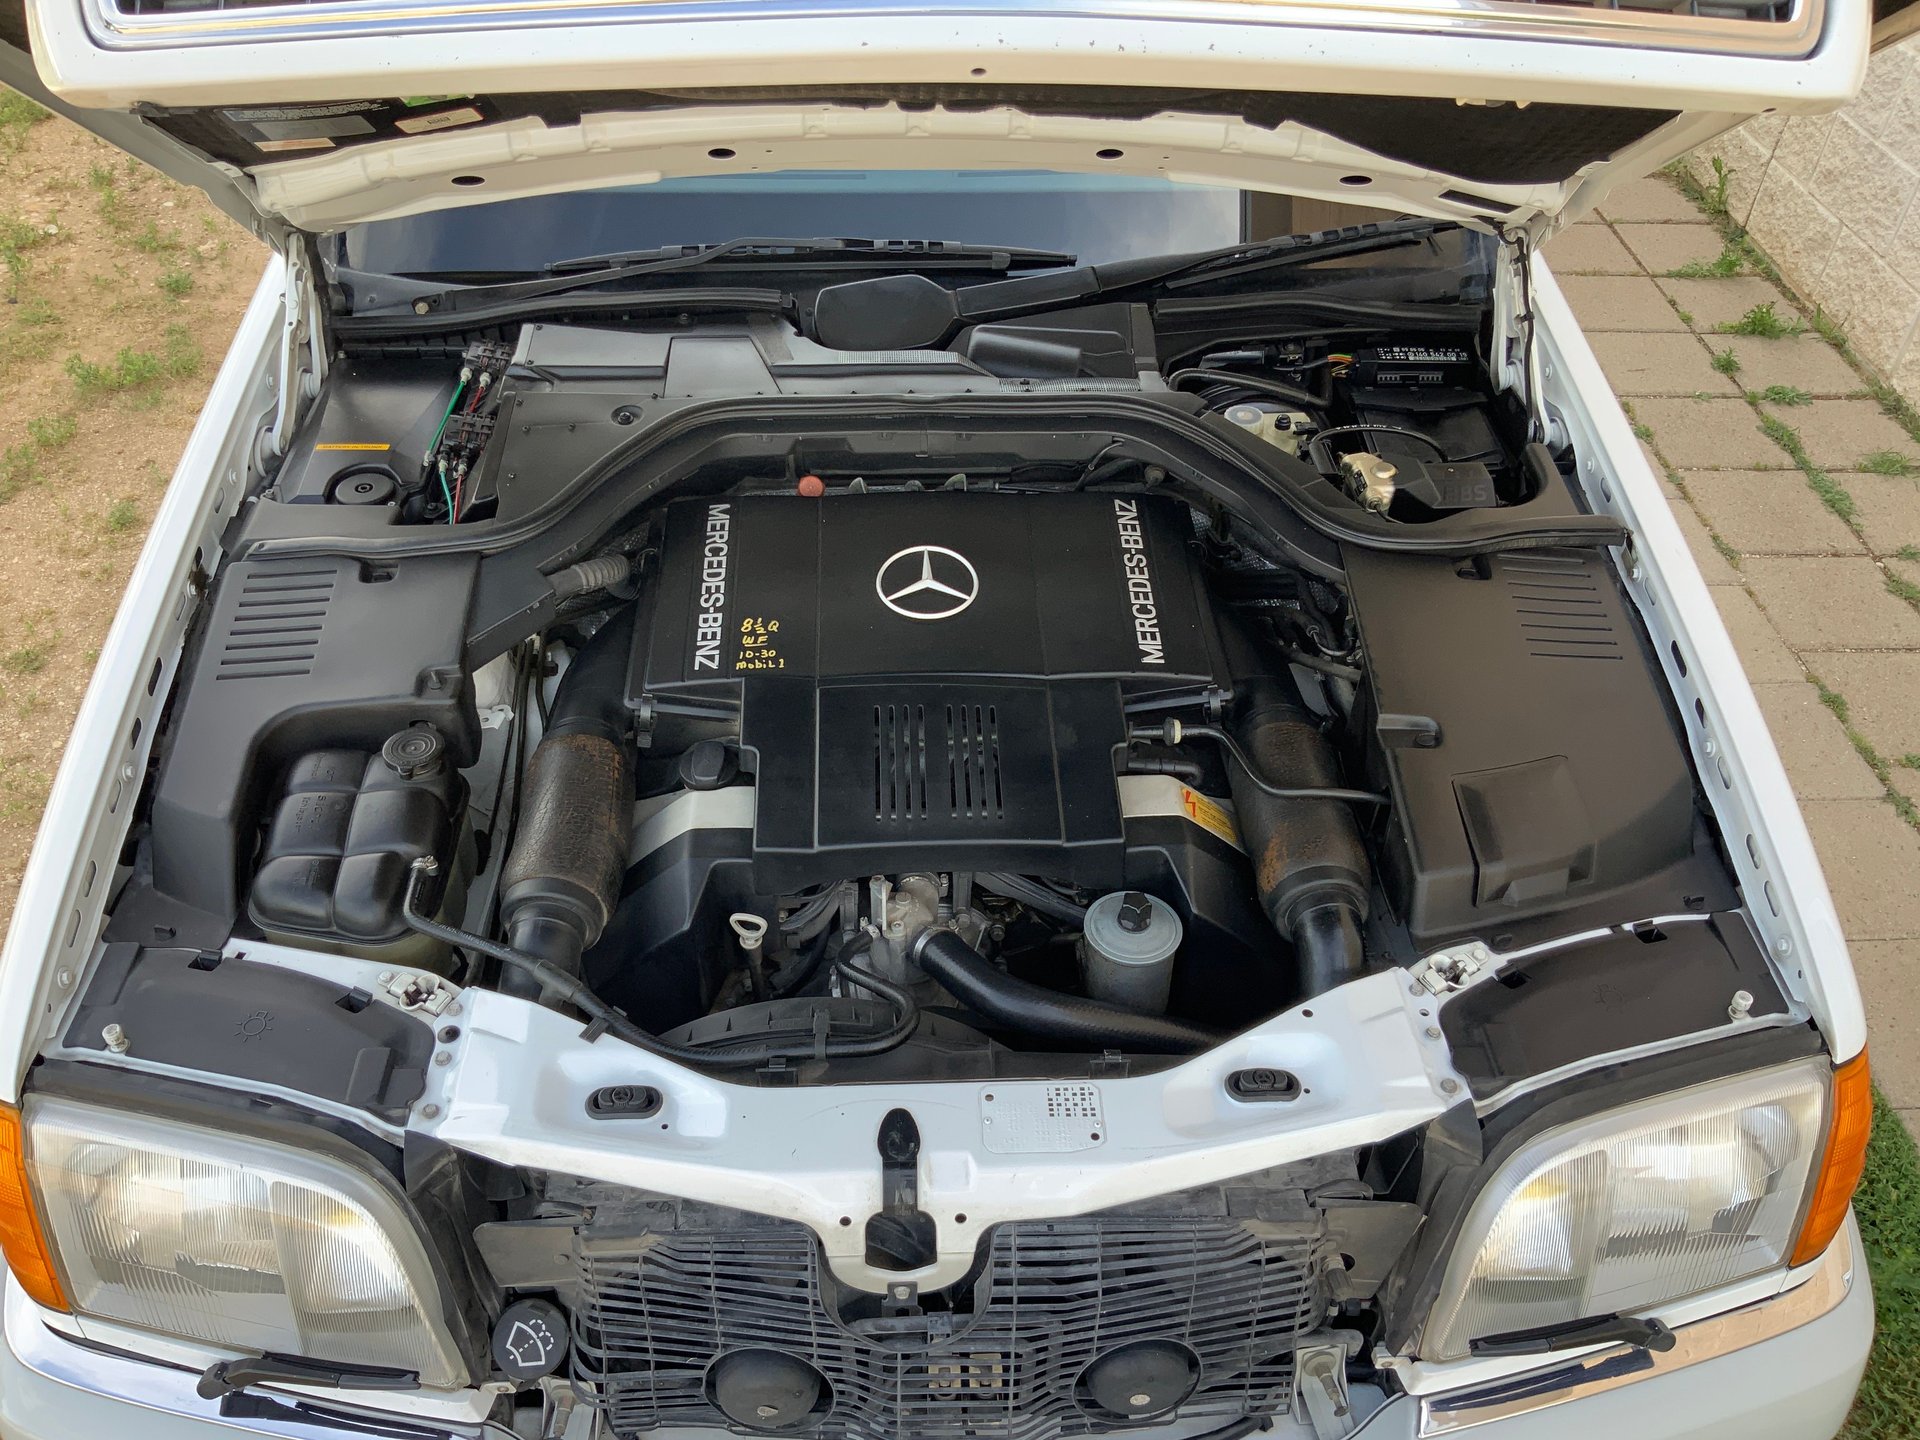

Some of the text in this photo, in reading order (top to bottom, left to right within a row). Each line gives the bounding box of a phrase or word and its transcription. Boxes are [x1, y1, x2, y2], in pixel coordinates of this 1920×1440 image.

[694, 503, 731, 671] MERCEDES-BENZ
[739, 649, 776, 659] 10-30
[1114, 499, 1165, 664] MERCEDES-BENZ
